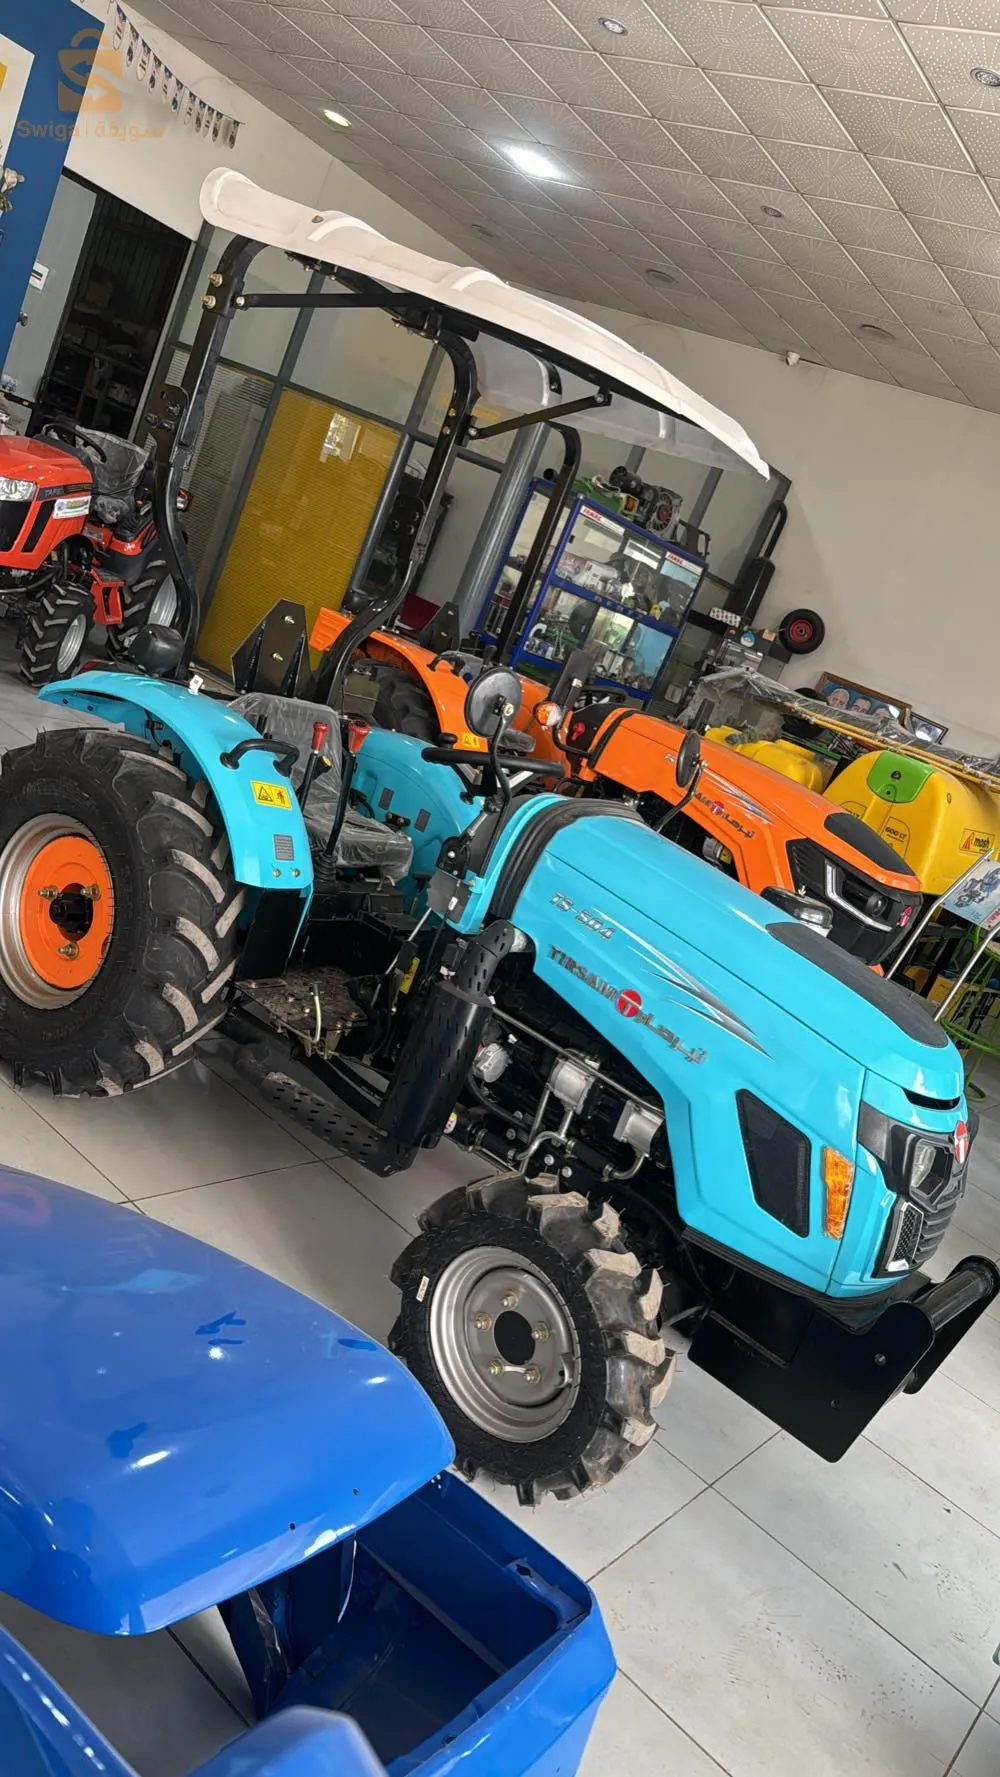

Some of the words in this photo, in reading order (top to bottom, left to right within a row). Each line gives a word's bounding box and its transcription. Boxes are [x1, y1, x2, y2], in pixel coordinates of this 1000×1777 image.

[885, 826, 899, 837] 600
[549, 891, 616, 940] TS-504
[548, 944, 618, 1001] TIRSAM
